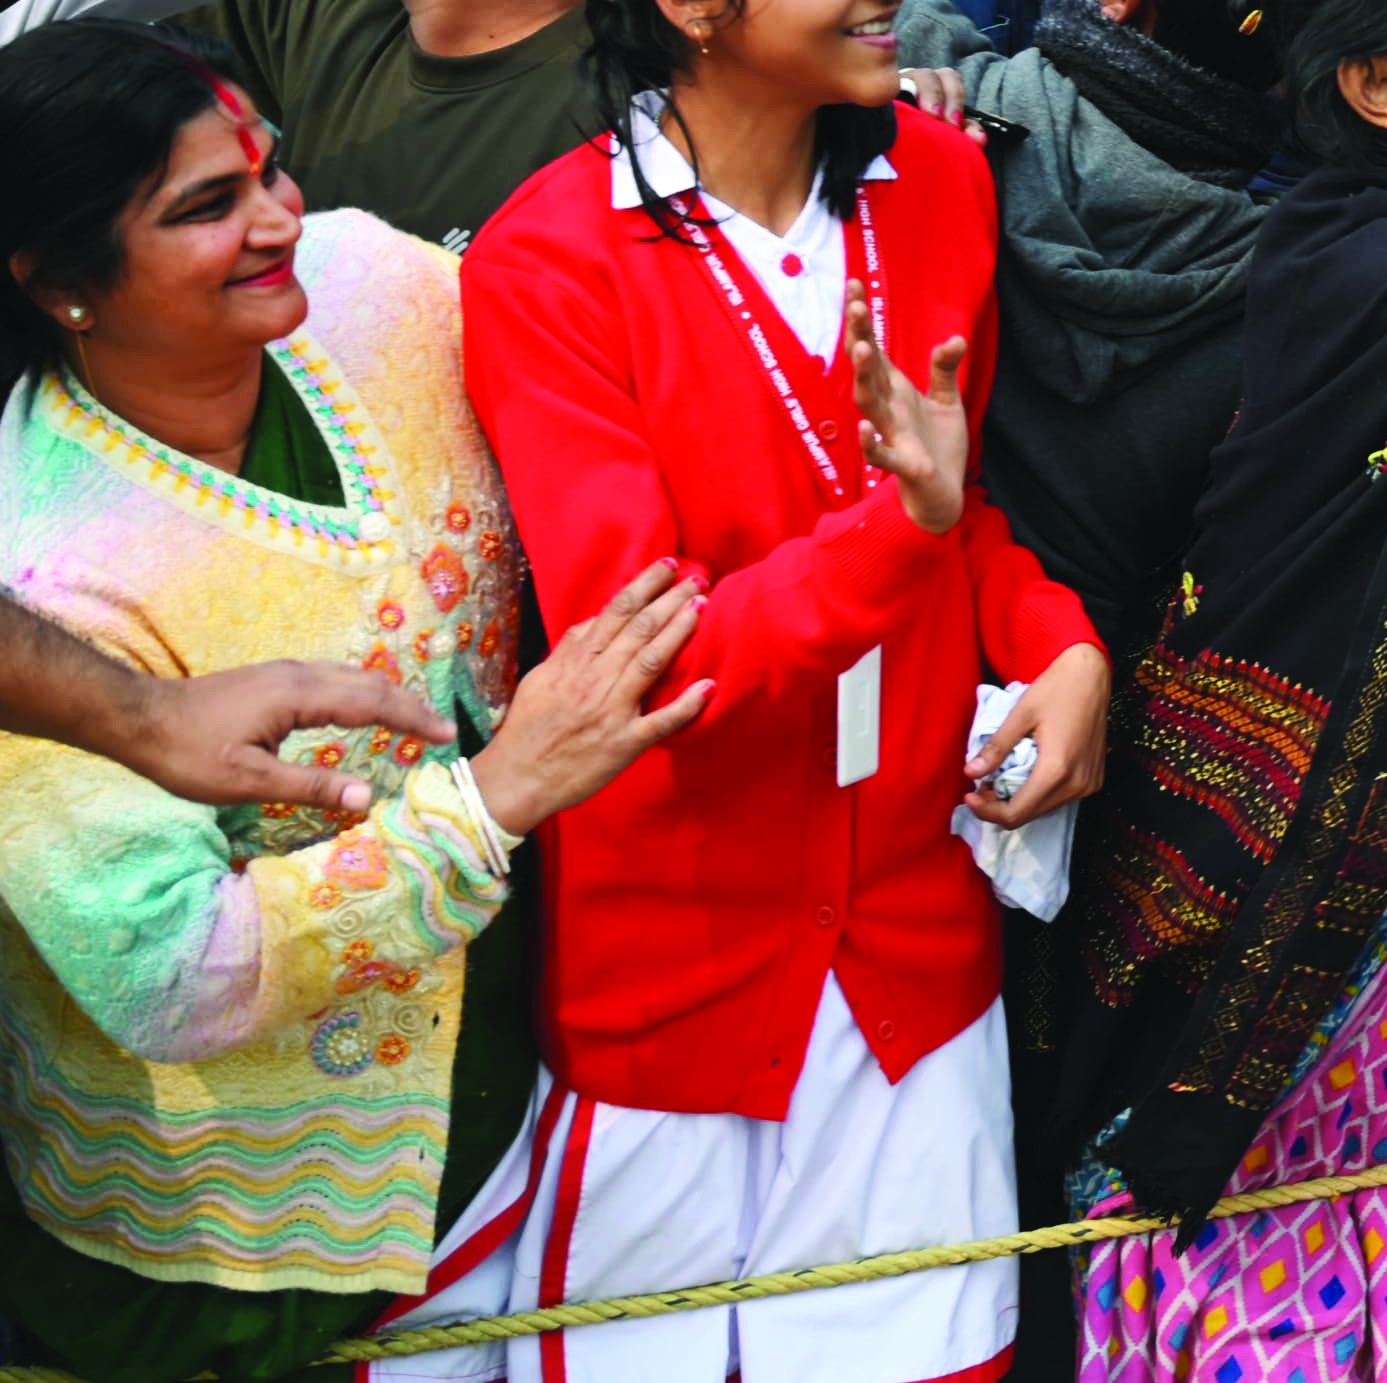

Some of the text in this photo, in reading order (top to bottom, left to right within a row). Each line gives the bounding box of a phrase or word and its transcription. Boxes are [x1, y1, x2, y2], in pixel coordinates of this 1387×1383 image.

[862, 228, 879, 273] SCHOOL
[748, 322, 778, 369] SCHOOL
[801, 428, 838, 482] ISLAMPUR
